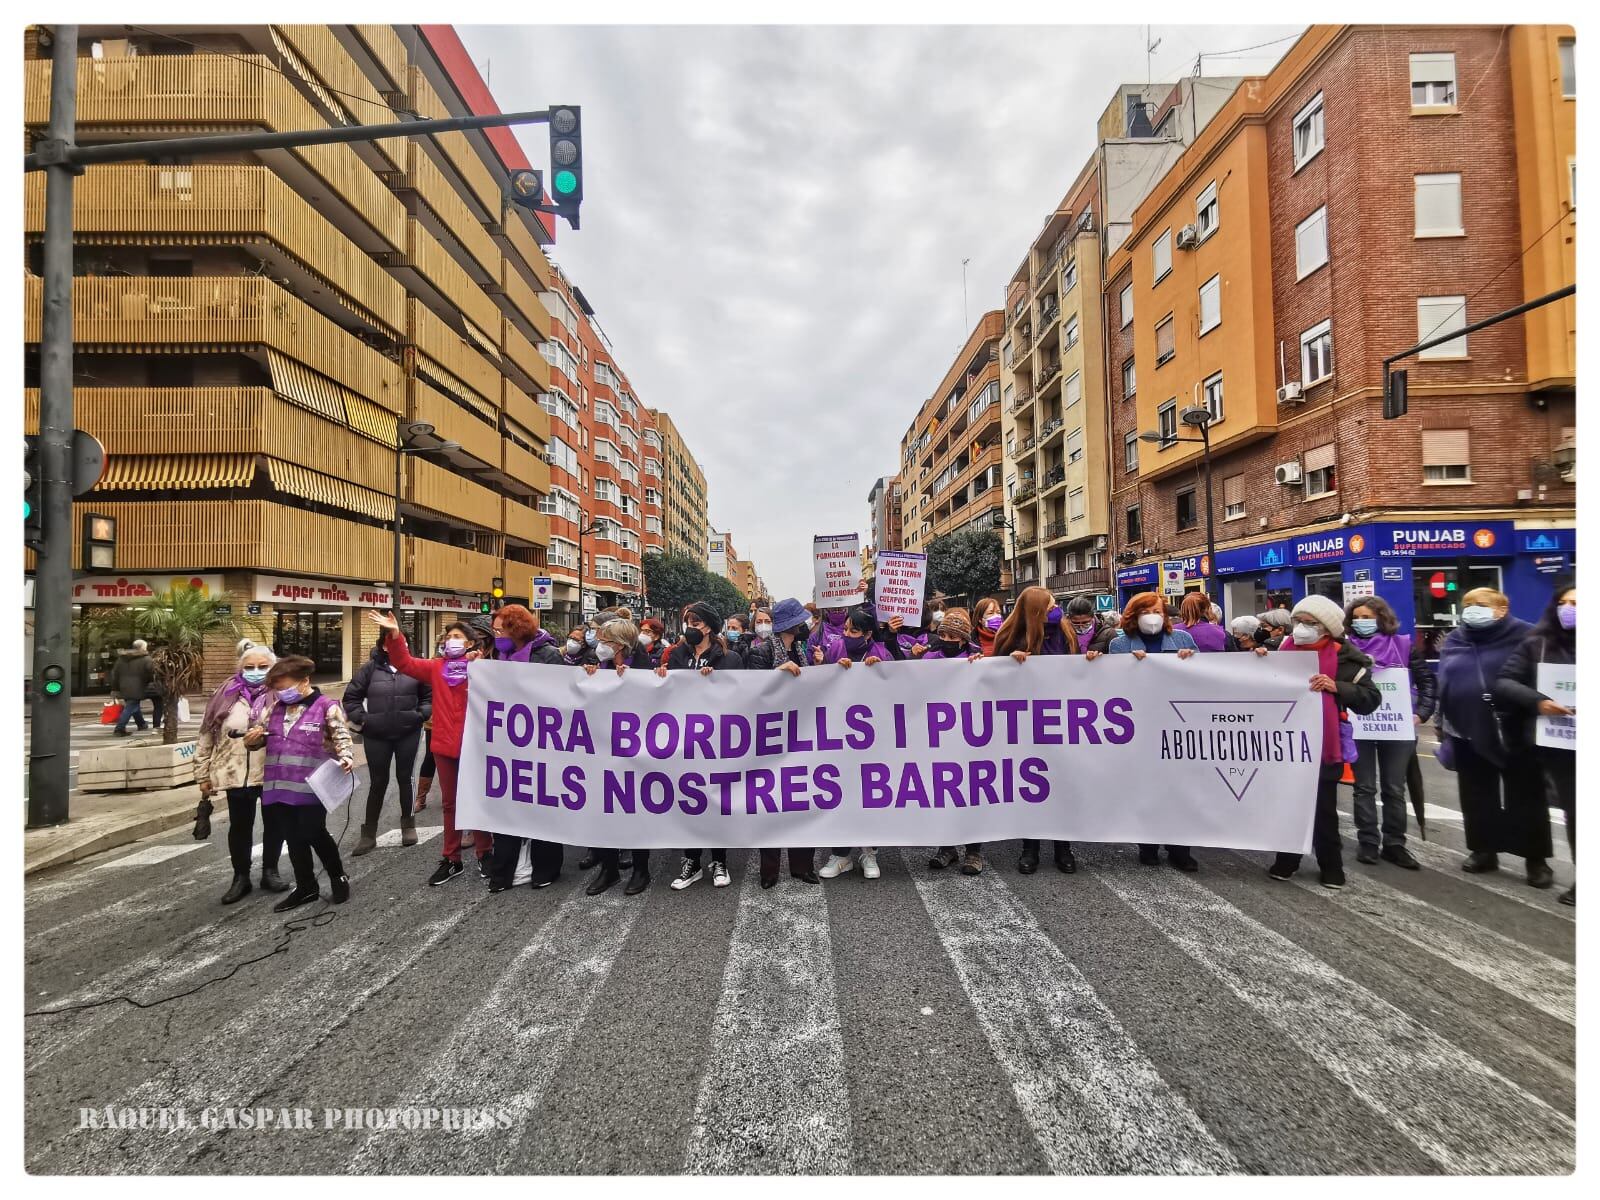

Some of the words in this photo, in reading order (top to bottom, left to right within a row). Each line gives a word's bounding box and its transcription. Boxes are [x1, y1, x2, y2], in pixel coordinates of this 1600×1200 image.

[1393, 529, 1465, 542] PUNJAB
[1297, 538, 1344, 555] PUNJAB
[1298, 550, 1344, 561] SUPERMERCADO
[886, 560, 918, 569] NUESTRAS
[901, 570, 922, 578] TIENEN
[92, 578, 153, 597] mira
[272, 584, 315, 601] super
[317, 584, 350, 601] mira
[882, 586, 915, 596] NUESTROS
[359, 591, 389, 606] super
[421, 597, 443, 609] super
[444, 596, 462, 608] mira
[880, 596, 907, 604] CUERPOS
[896, 606, 919, 615] PRECIO
[1380, 703, 1391, 711] LA
[1211, 714, 1254, 723] FRONT
[486, 700, 595, 754] FORA
[611, 704, 875, 759] BORDELLS
[893, 703, 907, 748] I
[927, 697, 1135, 748] PUTERS
[1363, 723, 1399, 732] SEXUAL
[1161, 729, 1312, 763] ABOLICIONISTA
[1229, 767, 1245, 777] PV
[485, 755, 586, 811] DELS
[603, 763, 843, 816] NOSTRES
[860, 757, 1050, 809] BARRIS
